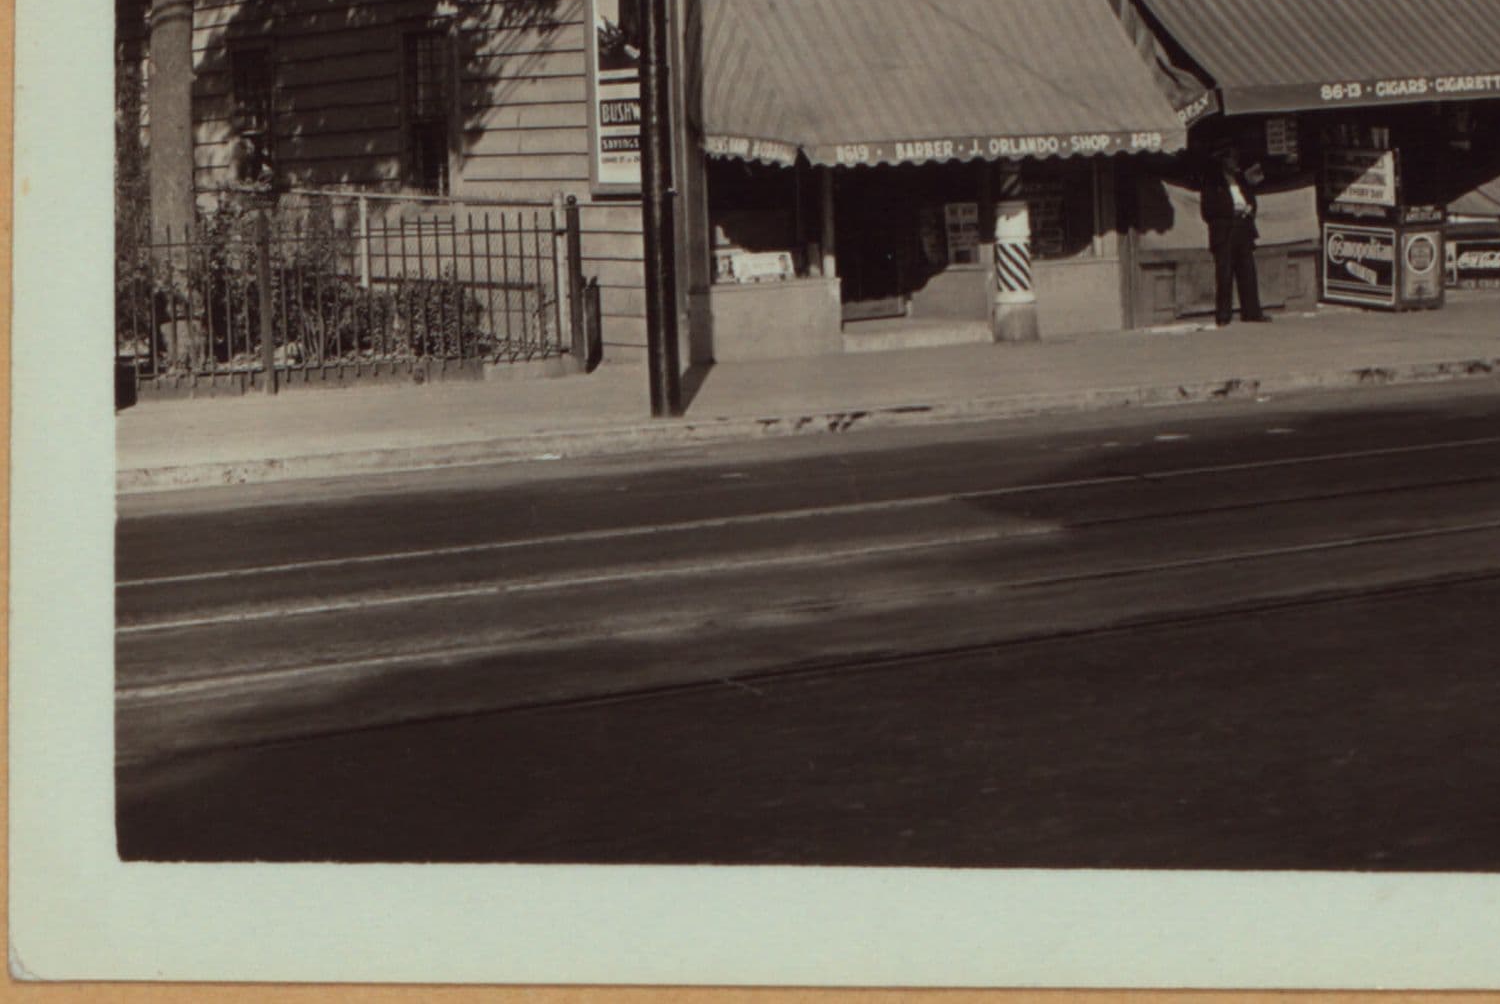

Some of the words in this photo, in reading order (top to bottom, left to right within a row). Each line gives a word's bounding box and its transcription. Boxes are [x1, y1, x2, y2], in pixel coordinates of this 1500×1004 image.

[1375, 78, 1427, 97] CIGARS
[602, 102, 640, 123] BUSHW
[895, 139, 953, 159] BARBER
[989, 136, 1058, 156] ORLANDO
[1070, 134, 1111, 152] SHOP
